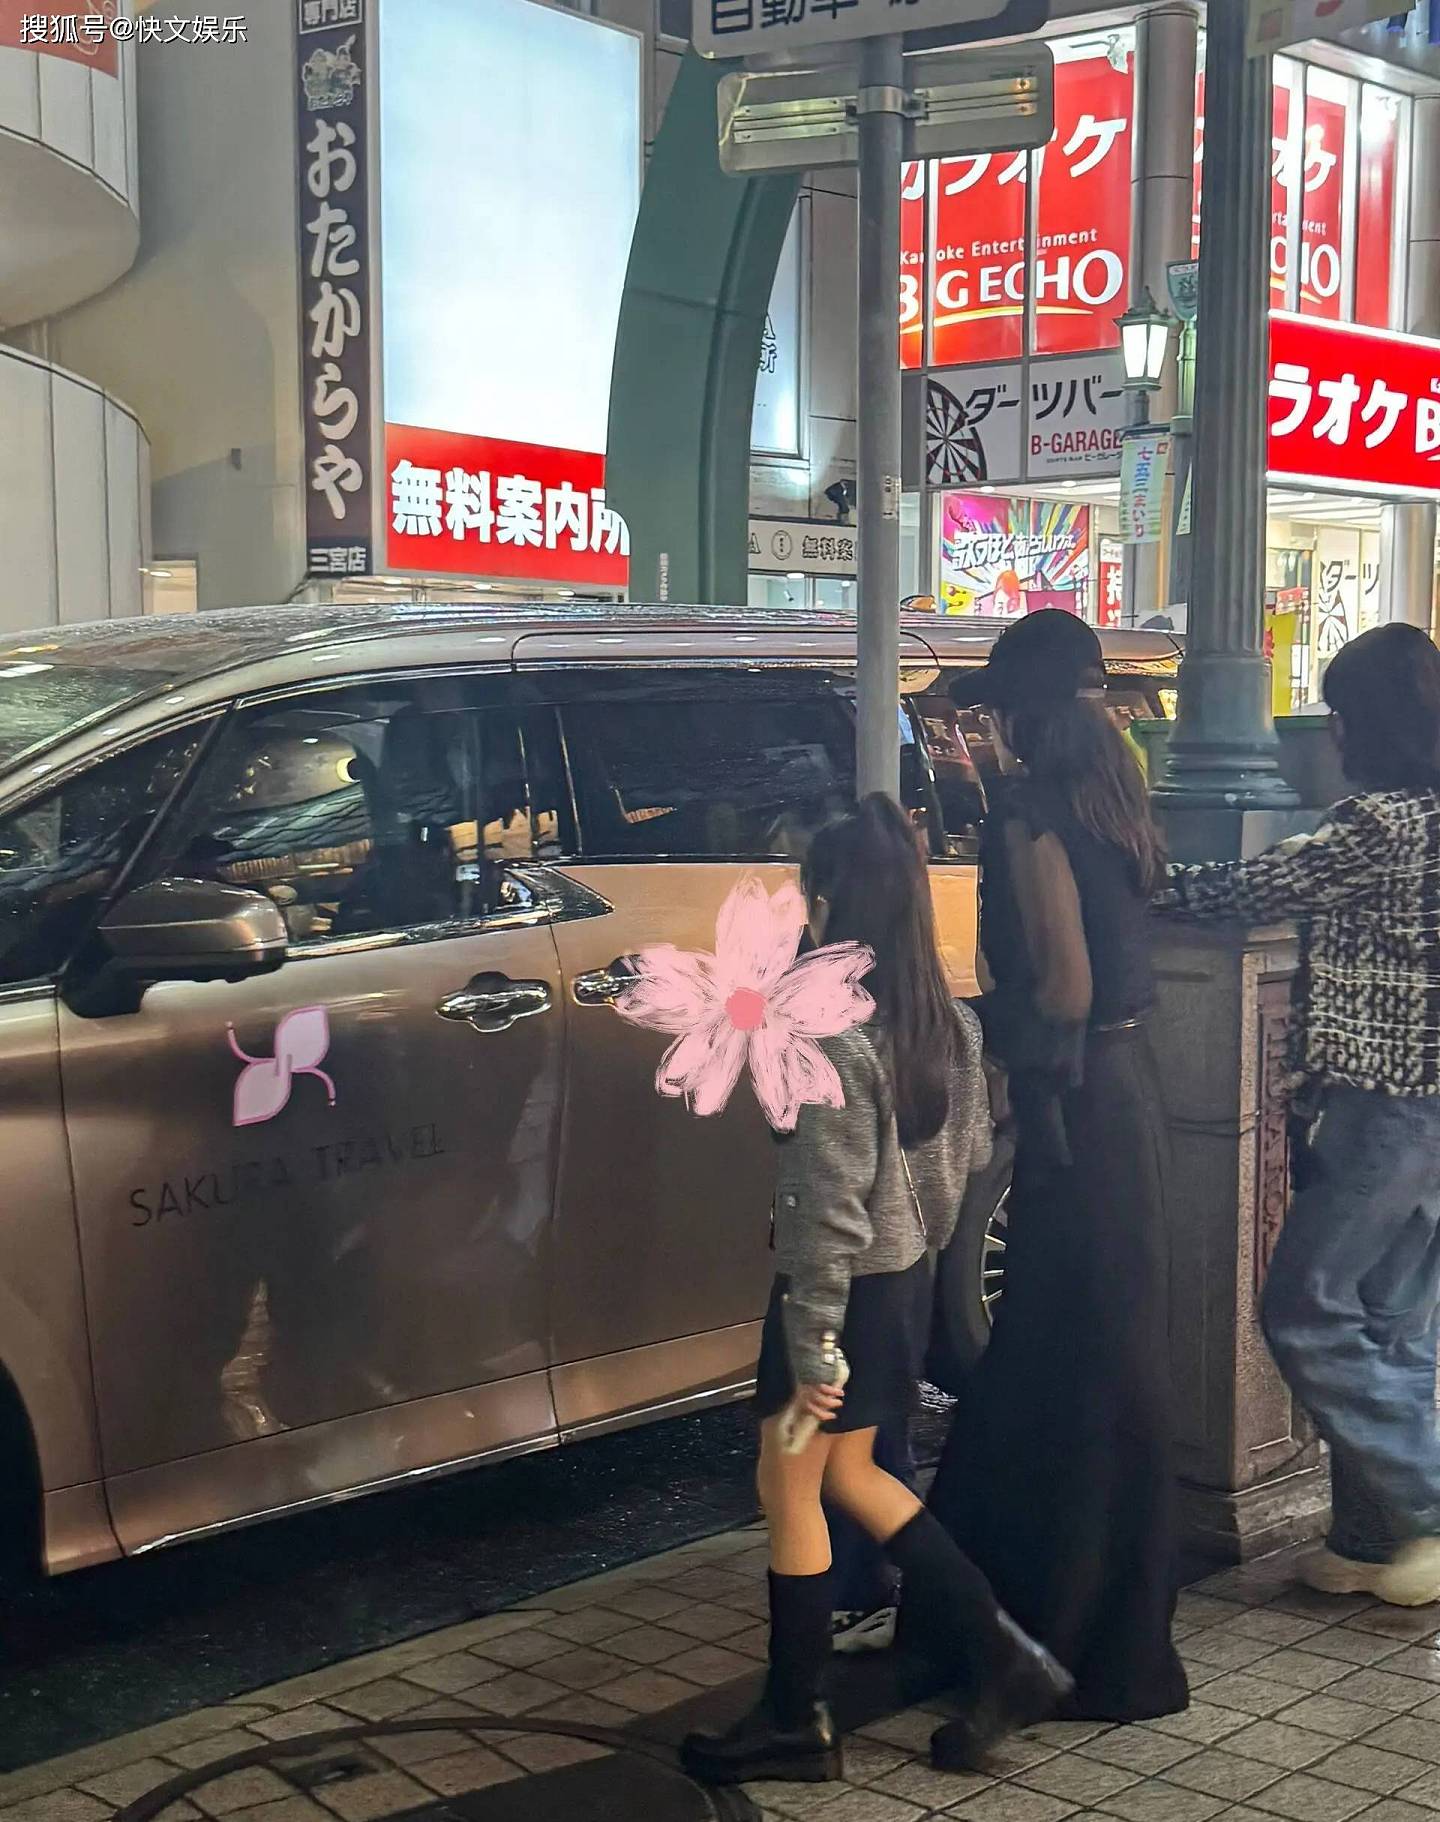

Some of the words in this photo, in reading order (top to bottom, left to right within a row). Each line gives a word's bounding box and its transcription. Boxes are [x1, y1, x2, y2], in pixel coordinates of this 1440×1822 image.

[306, 119, 362, 519] おたからや
[899, 269, 969, 323] BG
[980, 249, 1123, 305] ECHO
[966, 375, 1123, 426] ダーツバー
[391, 459, 631, 556] 無料案内所
[310, 546, 366, 572] 三宮店
